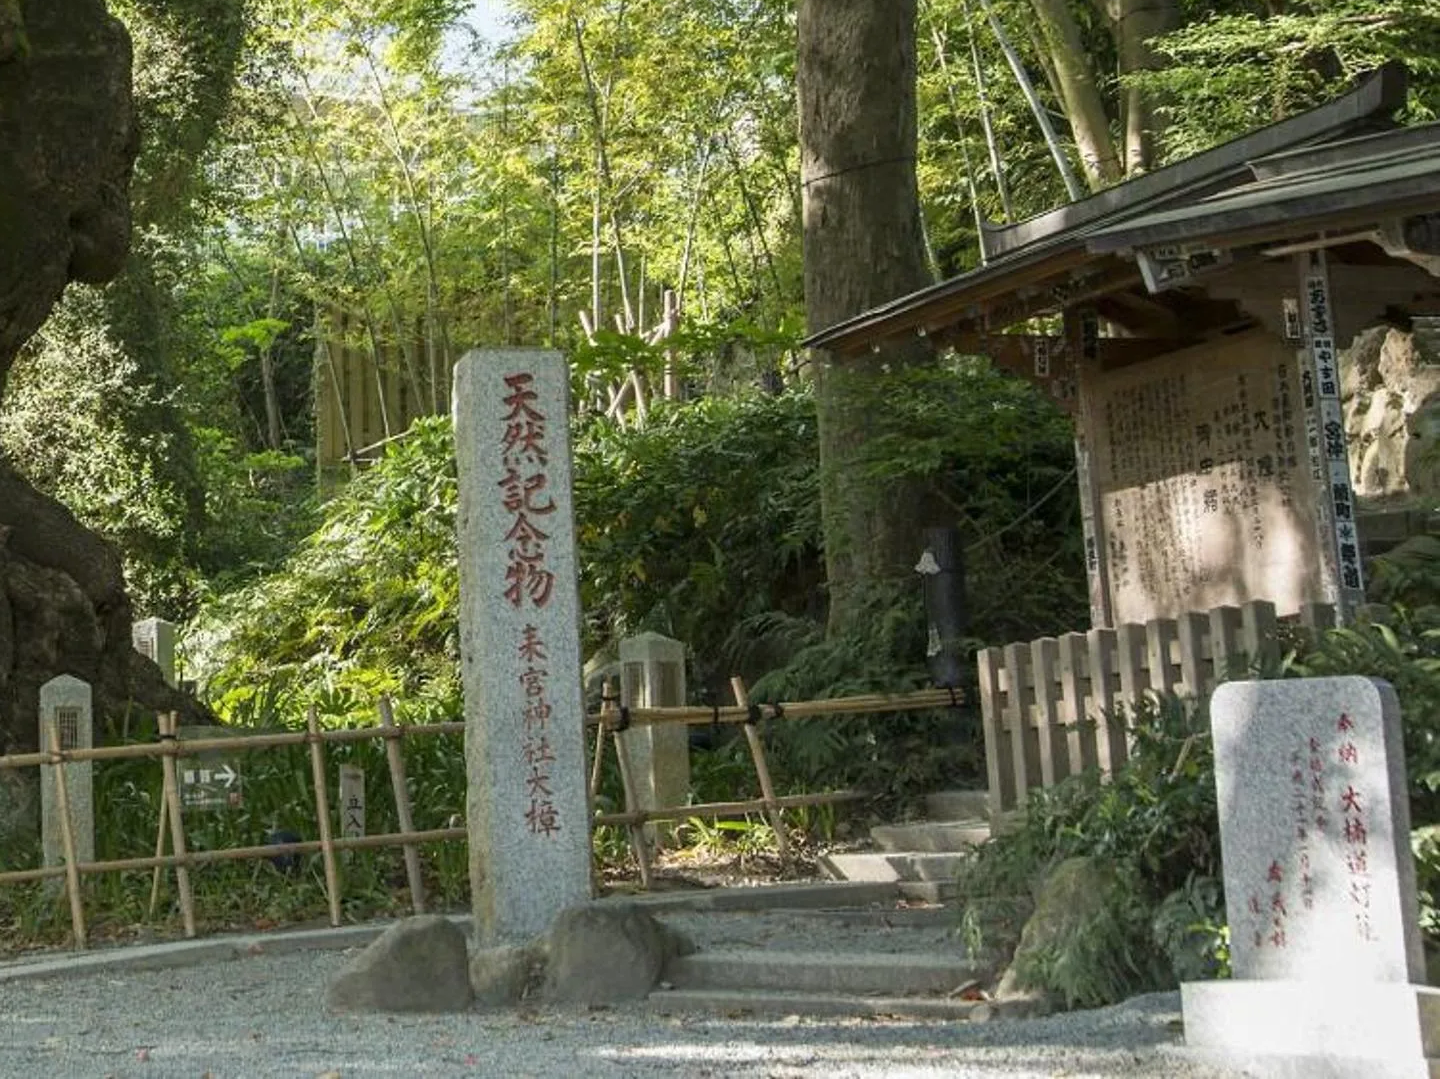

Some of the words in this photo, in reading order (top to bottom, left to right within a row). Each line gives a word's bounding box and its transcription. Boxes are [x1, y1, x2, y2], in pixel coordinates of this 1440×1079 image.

[498, 373, 557, 608] 天然記念物
[517, 623, 561, 837] 来宮神社大樟
